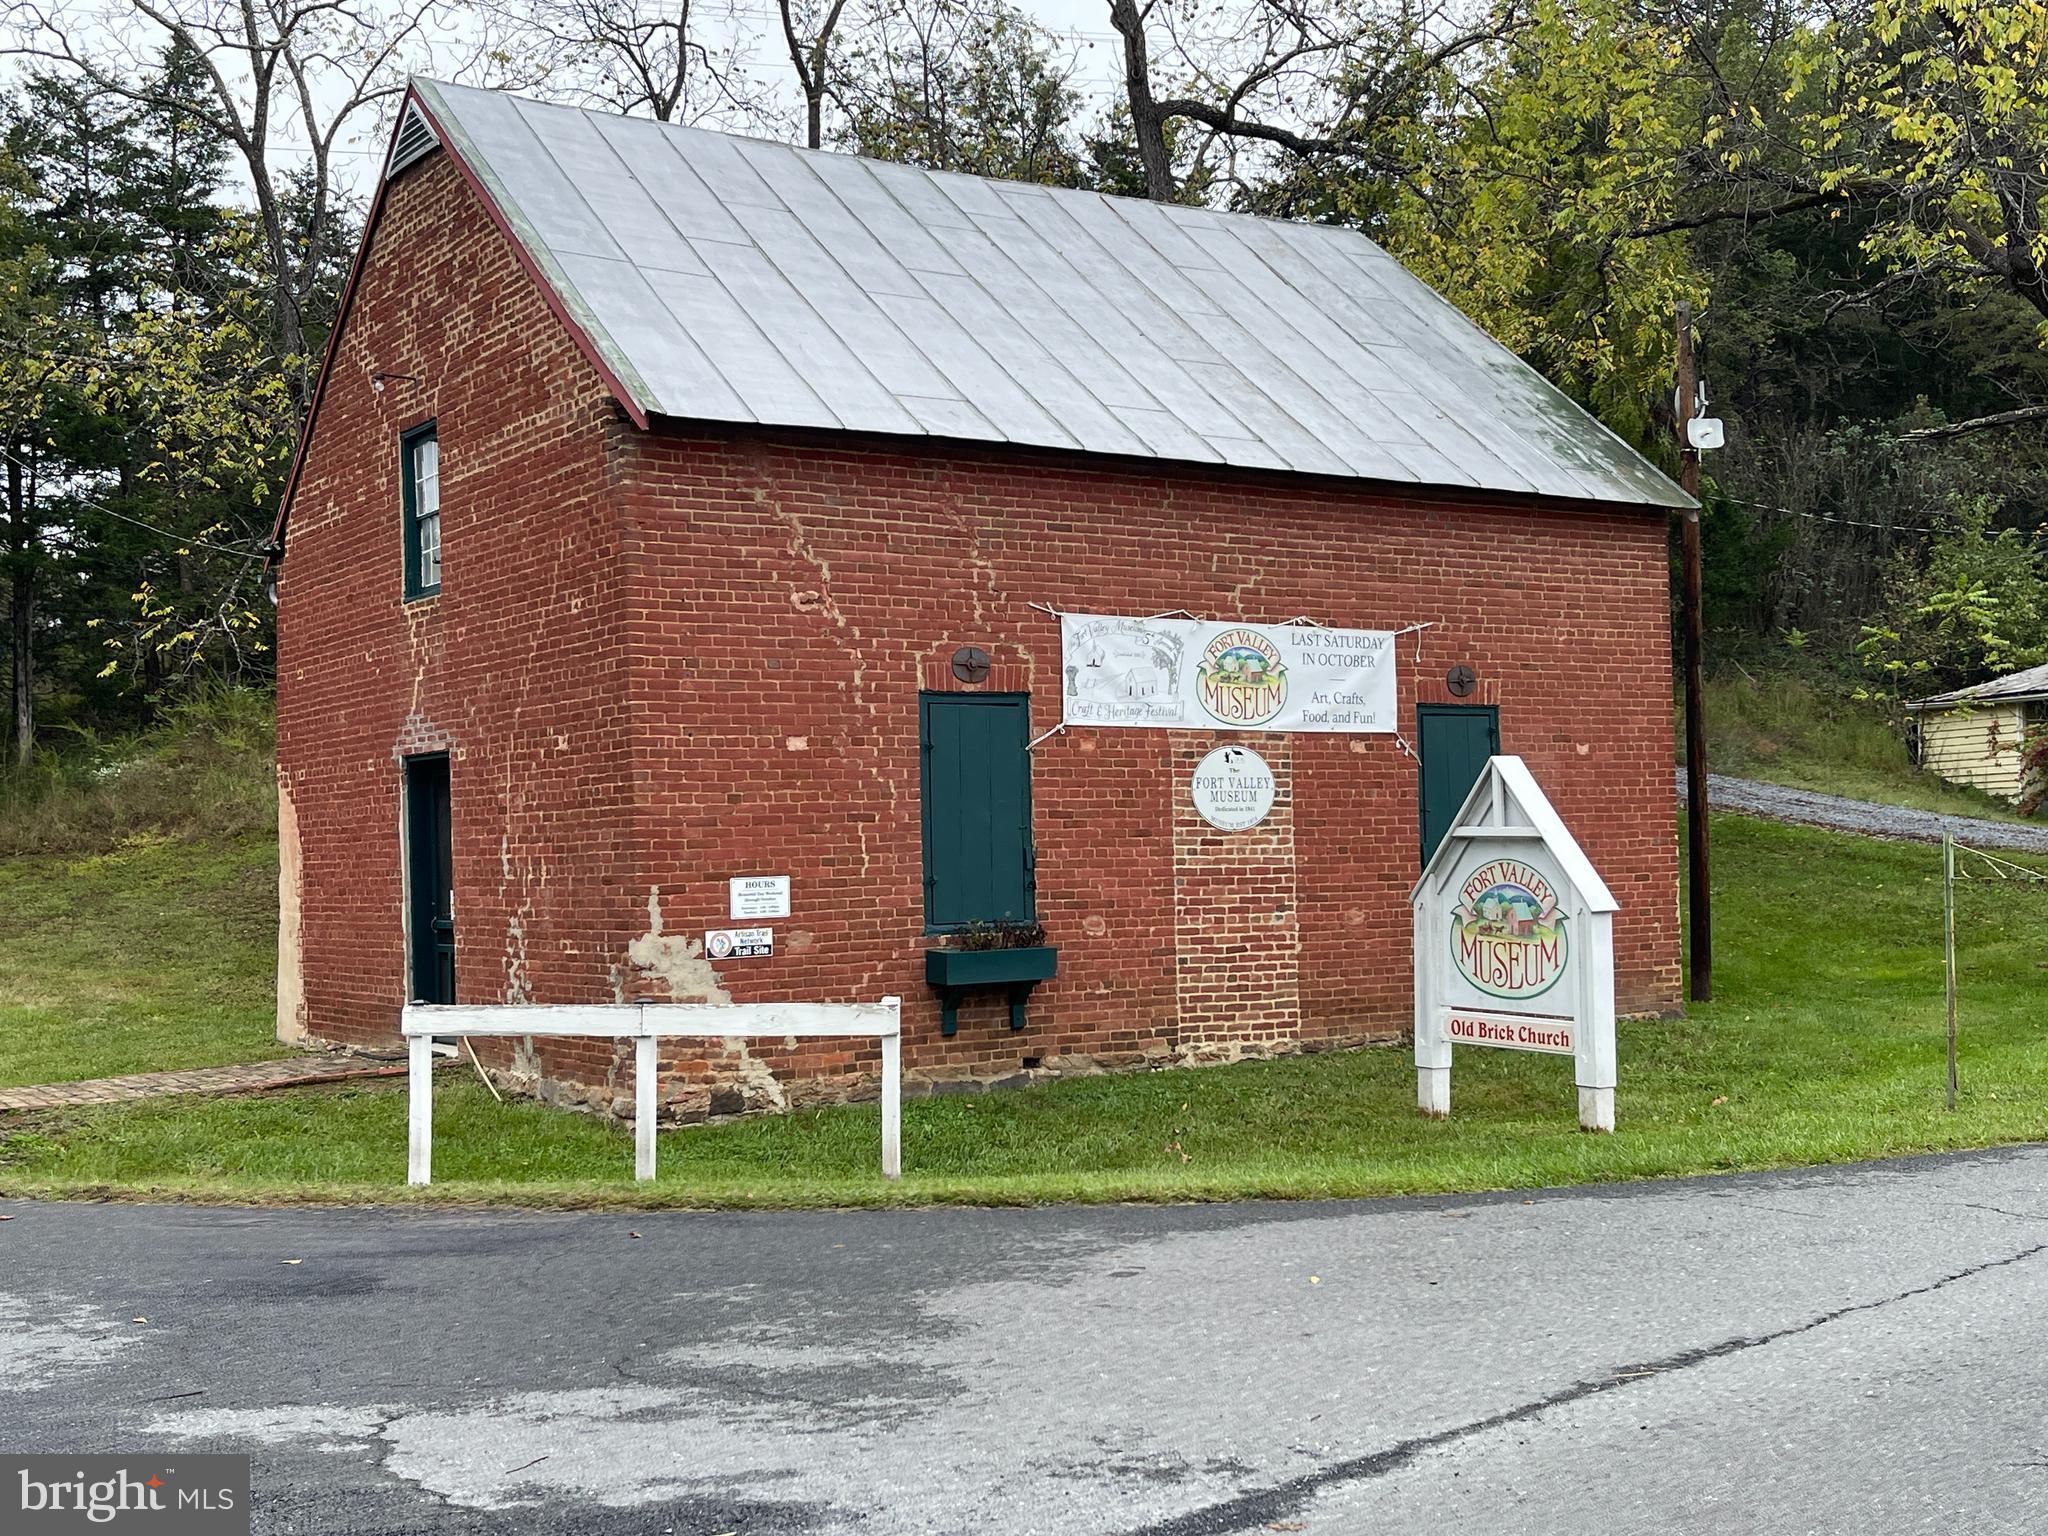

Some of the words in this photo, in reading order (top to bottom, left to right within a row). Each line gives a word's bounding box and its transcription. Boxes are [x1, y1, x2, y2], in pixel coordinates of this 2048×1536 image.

[1208, 633, 1234, 660] FORT
[1236, 631, 1278, 661] VALLEY
[1291, 632, 1322, 646] LAST
[1324, 634, 1385, 649] SATURDAY
[1302, 653, 1315, 665] IN
[1318, 654, 1375, 668] OCTOBER
[1204, 678, 1281, 720] MUSEUM
[1311, 692, 1331, 705] Art,
[1334, 691, 1366, 706] Crafts,
[1072, 700, 1093, 717] Craft
[1104, 703, 1143, 720] Heritage
[1145, 702, 1178, 718] Festival
[1302, 710, 1330, 724] Food,
[1332, 711, 1350, 723] and
[1353, 711, 1376, 724] Fun!
[1196, 776, 1224, 789] FORT
[1228, 776, 1271, 789] VALLEY
[1210, 790, 1257, 803] MUSEUM
[745, 880, 776, 888] HOURS
[1463, 865, 1496, 903] FORT
[1498, 862, 1553, 903] VALLEY
[734, 946, 751, 955] Trail
[753, 945, 769, 954] Site
[1459, 928, 1560, 990] MUSEUM
[1451, 1019, 1474, 1037] Old
[1478, 1022, 1514, 1041] Brick
[1518, 1026, 1569, 1047] Church
